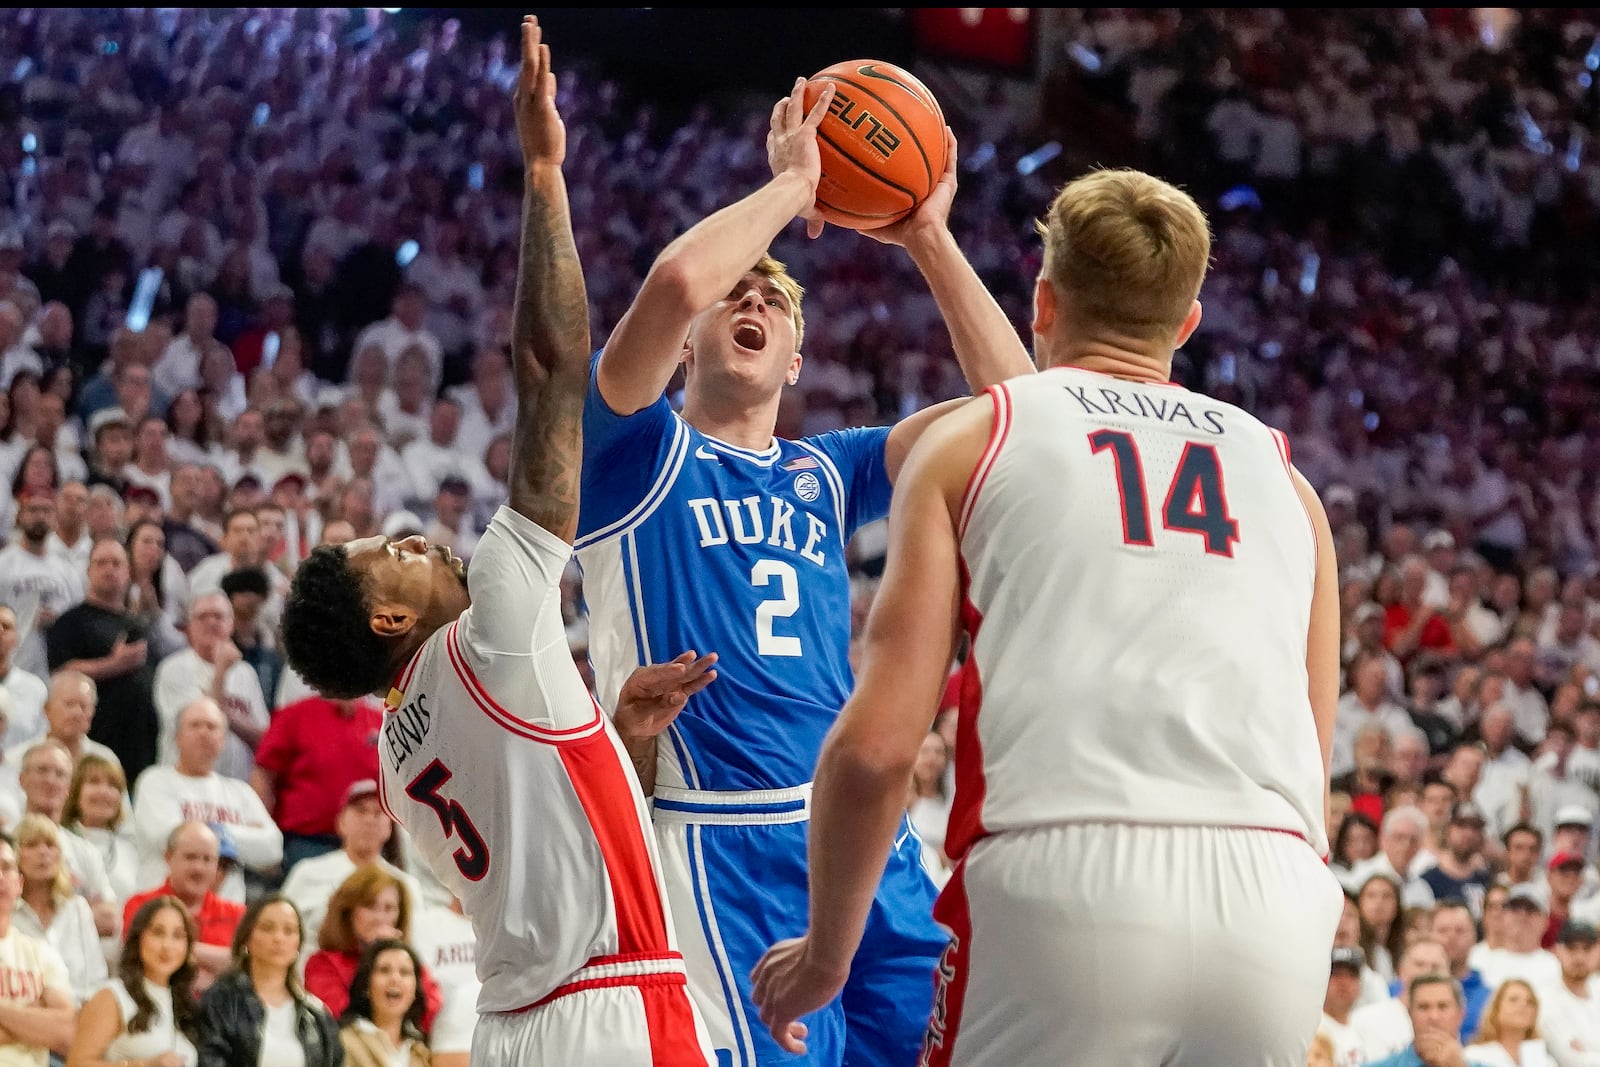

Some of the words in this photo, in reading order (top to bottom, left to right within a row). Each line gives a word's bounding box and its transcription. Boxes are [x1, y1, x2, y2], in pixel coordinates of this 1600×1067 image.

[828, 90, 902, 159] ELITE
[1065, 386, 1226, 435] KRIVAS
[687, 495, 828, 567] DUKE
[1087, 428, 1241, 559] 14
[751, 558, 803, 657] 2
[385, 693, 431, 774] LEWIS
[405, 757, 491, 882] 5
